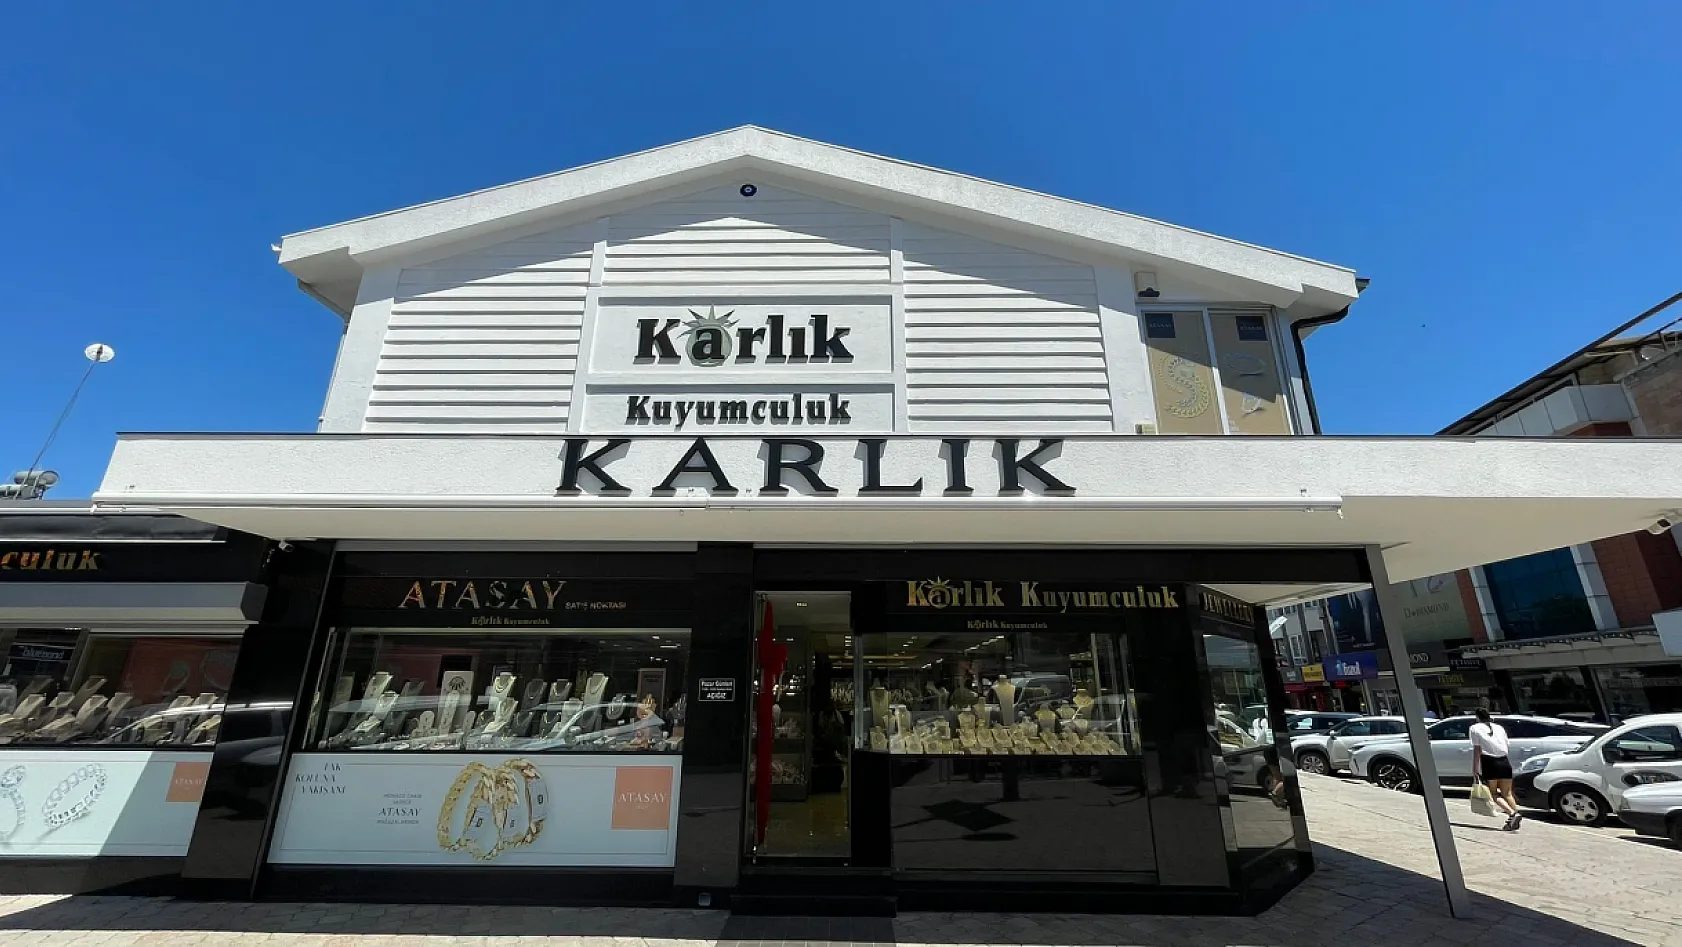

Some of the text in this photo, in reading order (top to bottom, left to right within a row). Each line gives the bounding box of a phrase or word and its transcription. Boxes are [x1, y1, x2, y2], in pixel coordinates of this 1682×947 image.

[632, 313, 855, 366] Karlık
[623, 393, 852, 431] Kuyumculuk
[554, 438, 1077, 498] KARLIK
[398, 580, 567, 609] ATASAY
[906, 577, 1179, 613] Karlık Kuyumculuk
[378, 807, 421, 817] ATASAY
[618, 792, 668, 803] ATASAY
